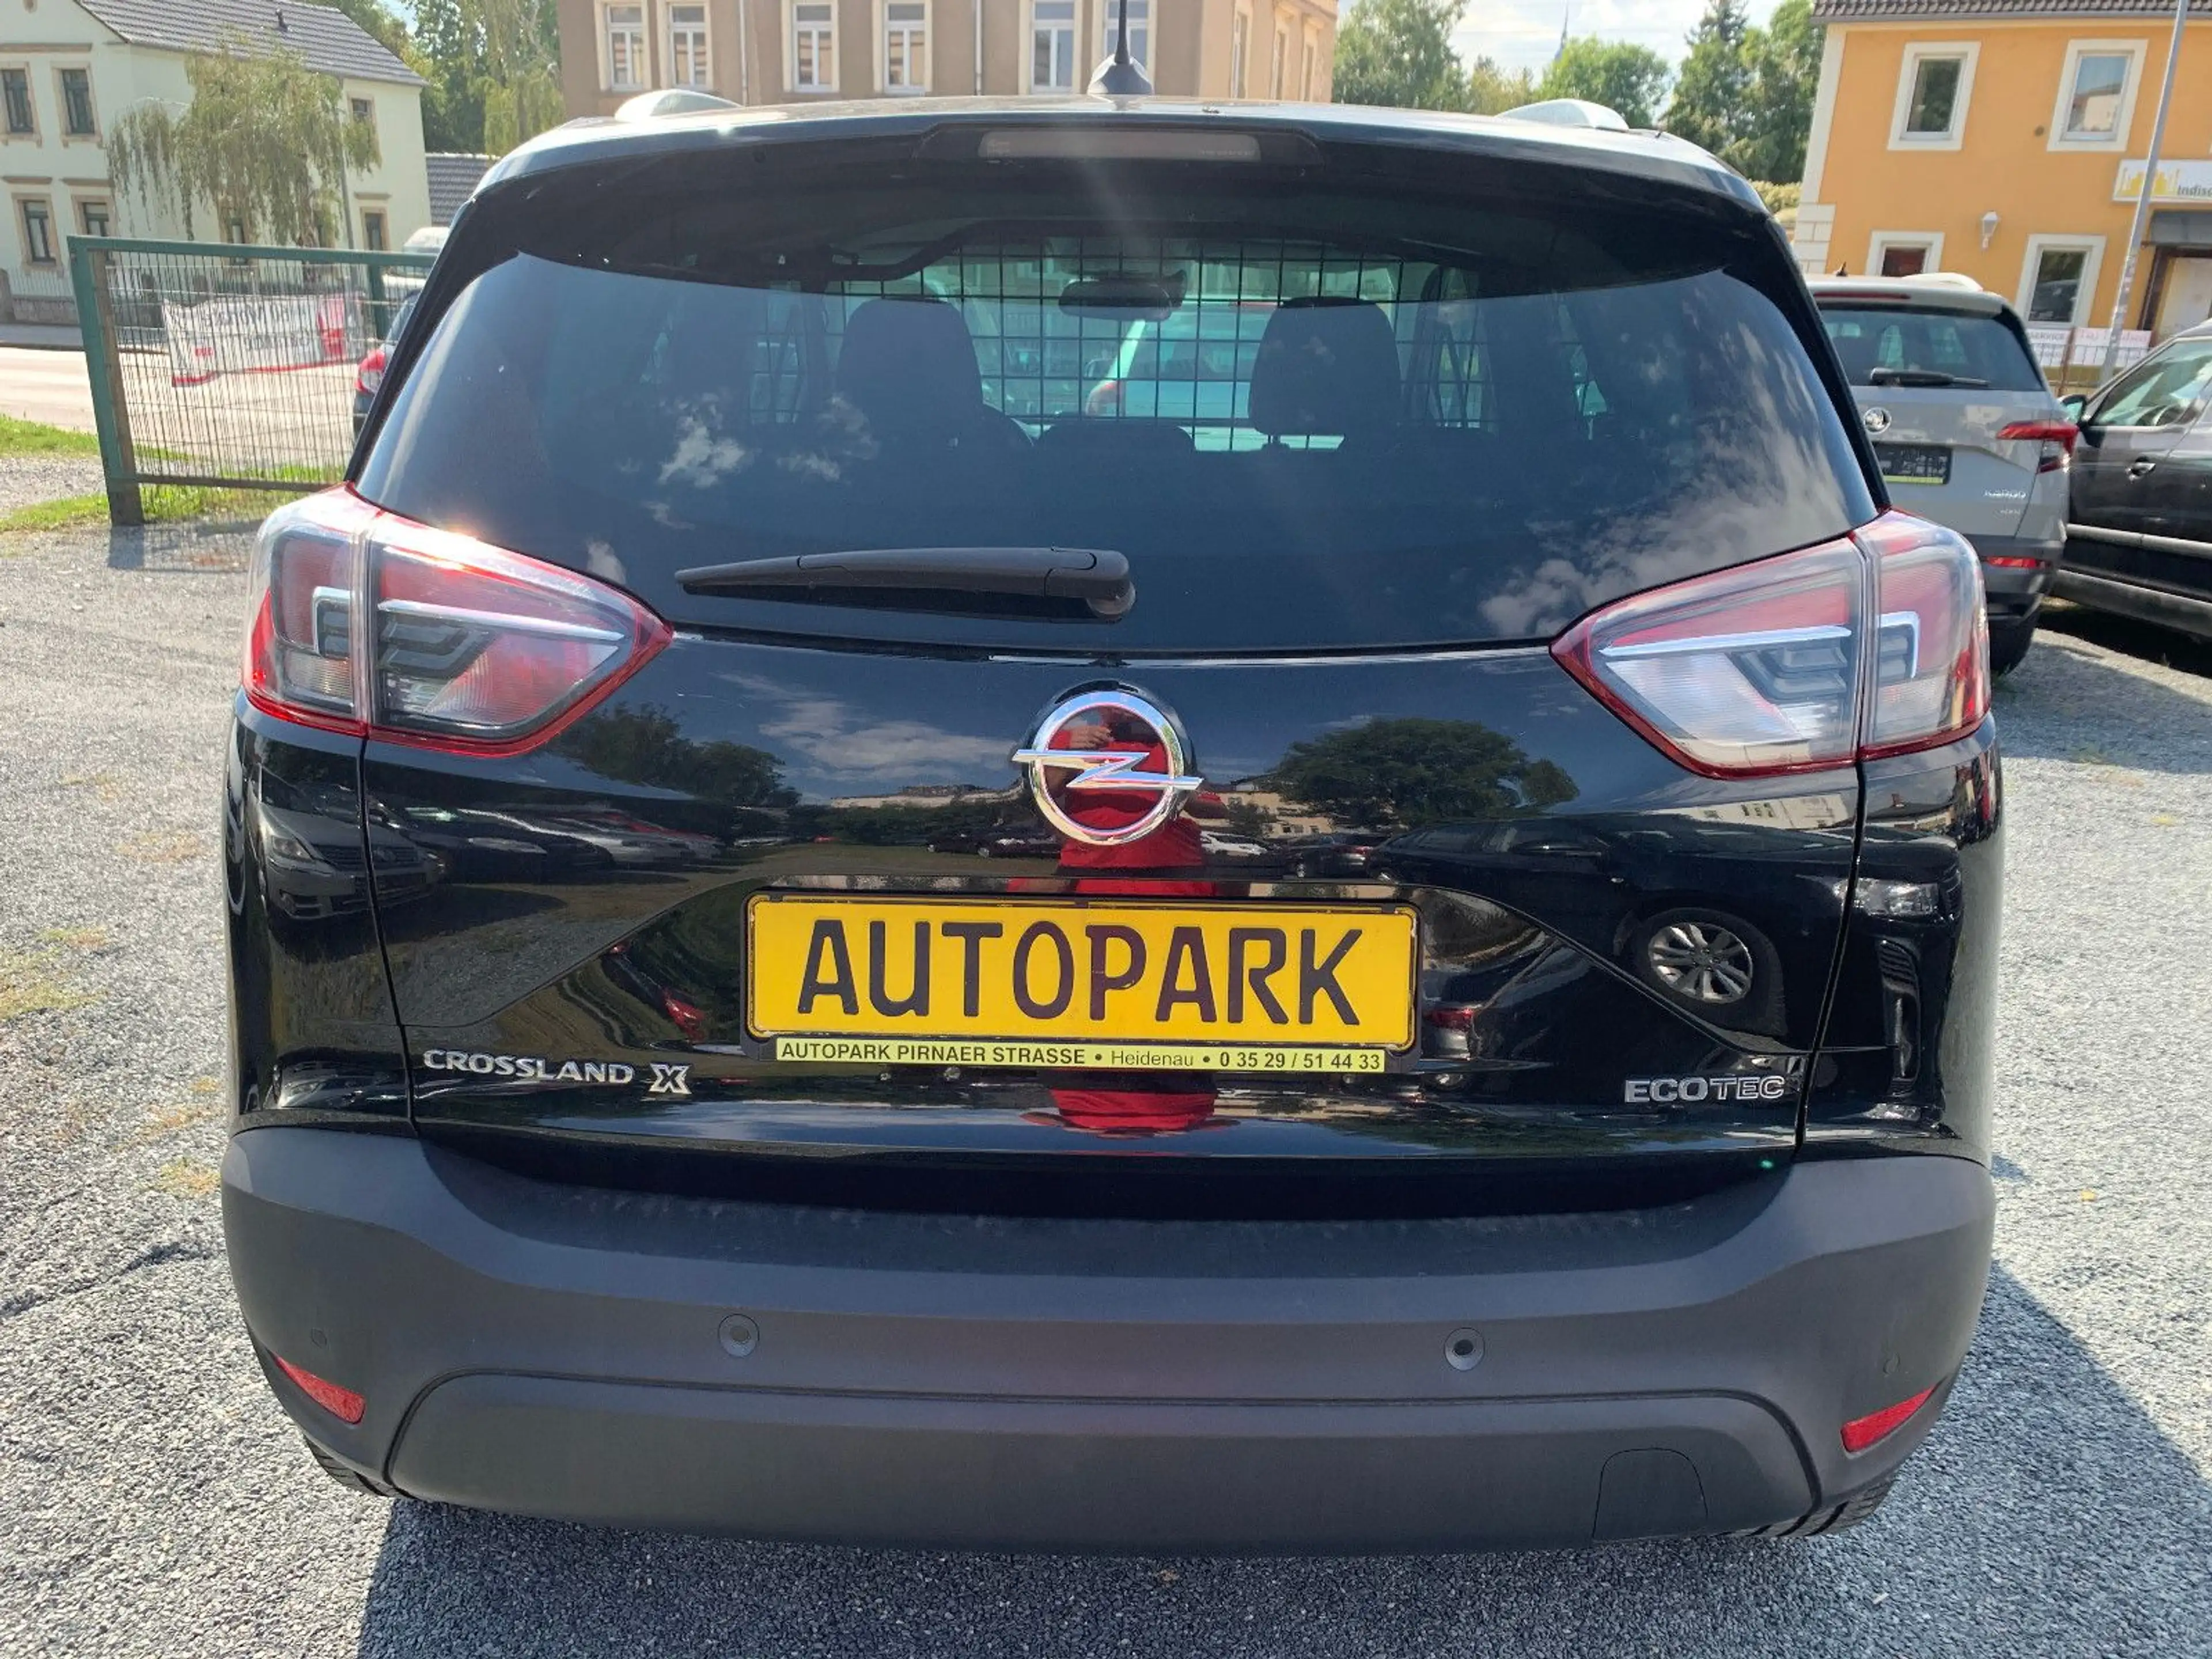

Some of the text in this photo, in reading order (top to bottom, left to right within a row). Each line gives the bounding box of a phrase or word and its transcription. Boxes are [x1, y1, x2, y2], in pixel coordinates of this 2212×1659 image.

[797, 919, 1363, 1025] AUTOPARK
[423, 1049, 692, 1094] CROSSLAND X
[782, 1043, 891, 1060] AUTOPARK
[897, 1045, 986, 1062] PIRNAER
[993, 1047, 1085, 1065] STRASSE
[1111, 1050, 1194, 1067] Heidenau
[1237, 1052, 1258, 1068] 35
[1264, 1052, 1286, 1069] 29
[1303, 1053, 1323, 1069] 51
[1331, 1054, 1353, 1070] 44
[1358, 1054, 1381, 1070] 33
[1624, 1075, 1785, 1103] ECOTEC
